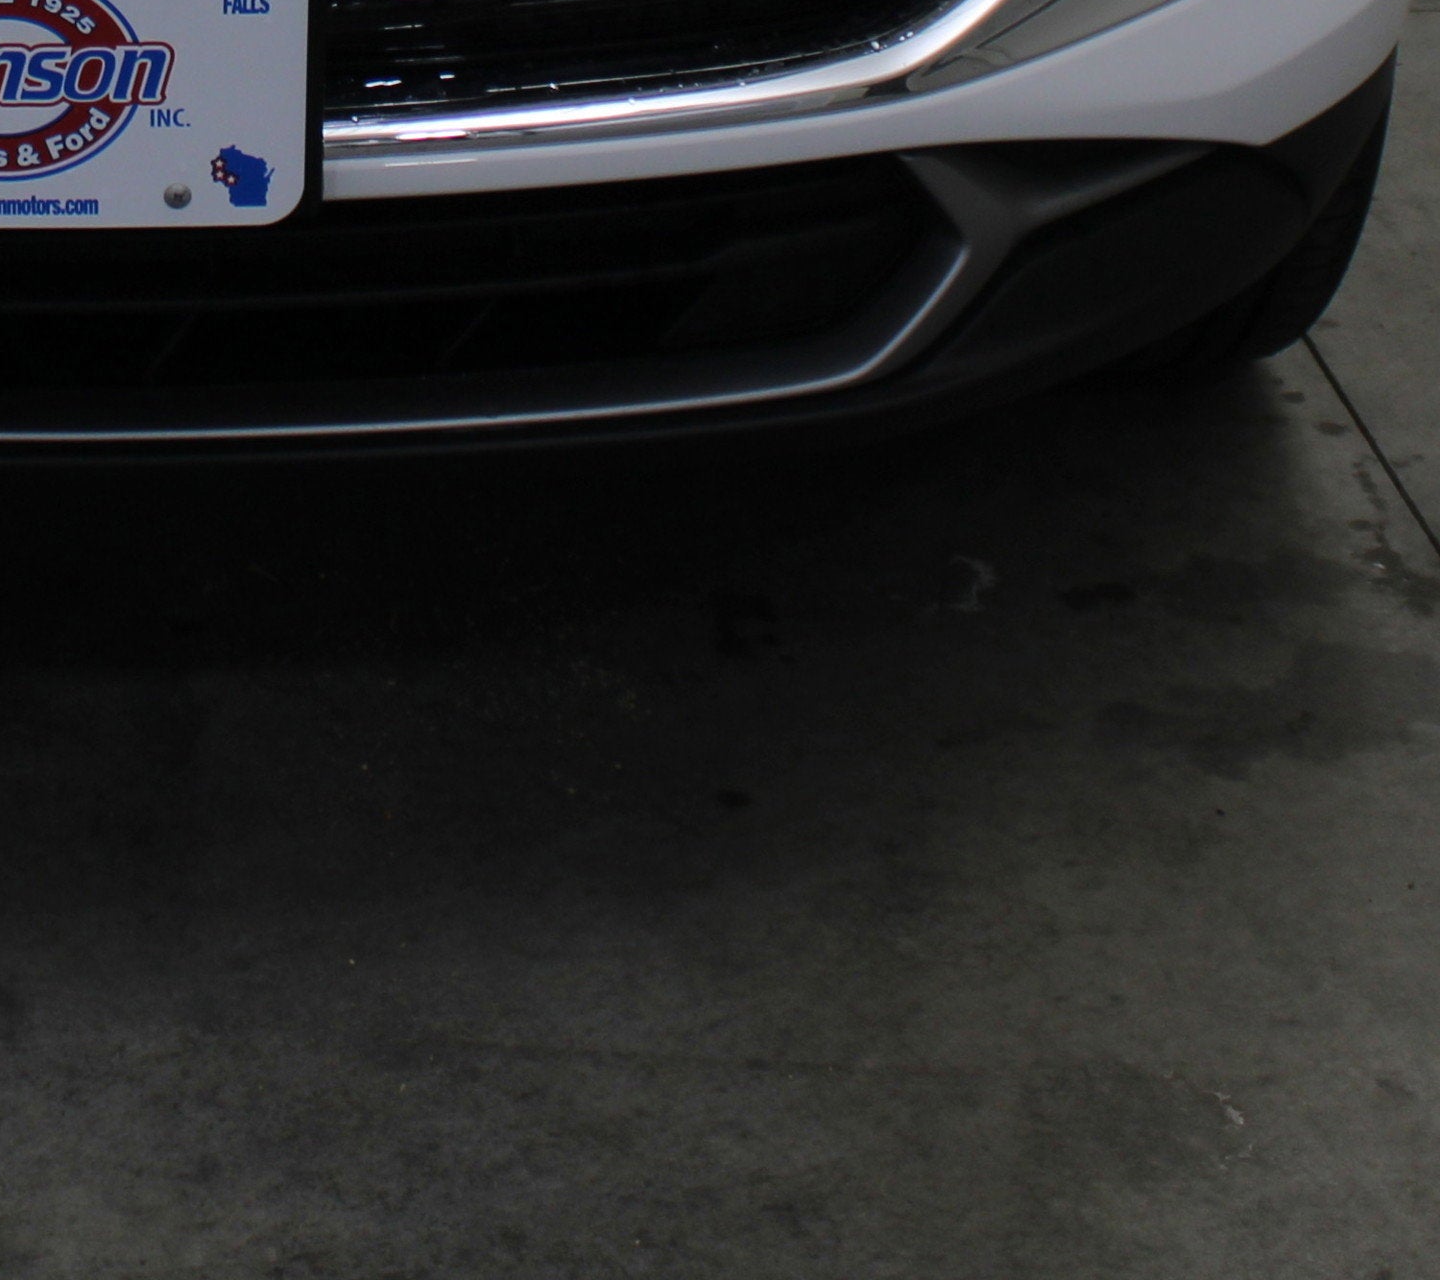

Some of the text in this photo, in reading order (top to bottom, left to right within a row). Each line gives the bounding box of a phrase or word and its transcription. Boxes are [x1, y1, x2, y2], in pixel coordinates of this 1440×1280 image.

[16, 143, 41, 167] &
[46, 106, 111, 161] Ford
[149, 108, 192, 128] INC.
